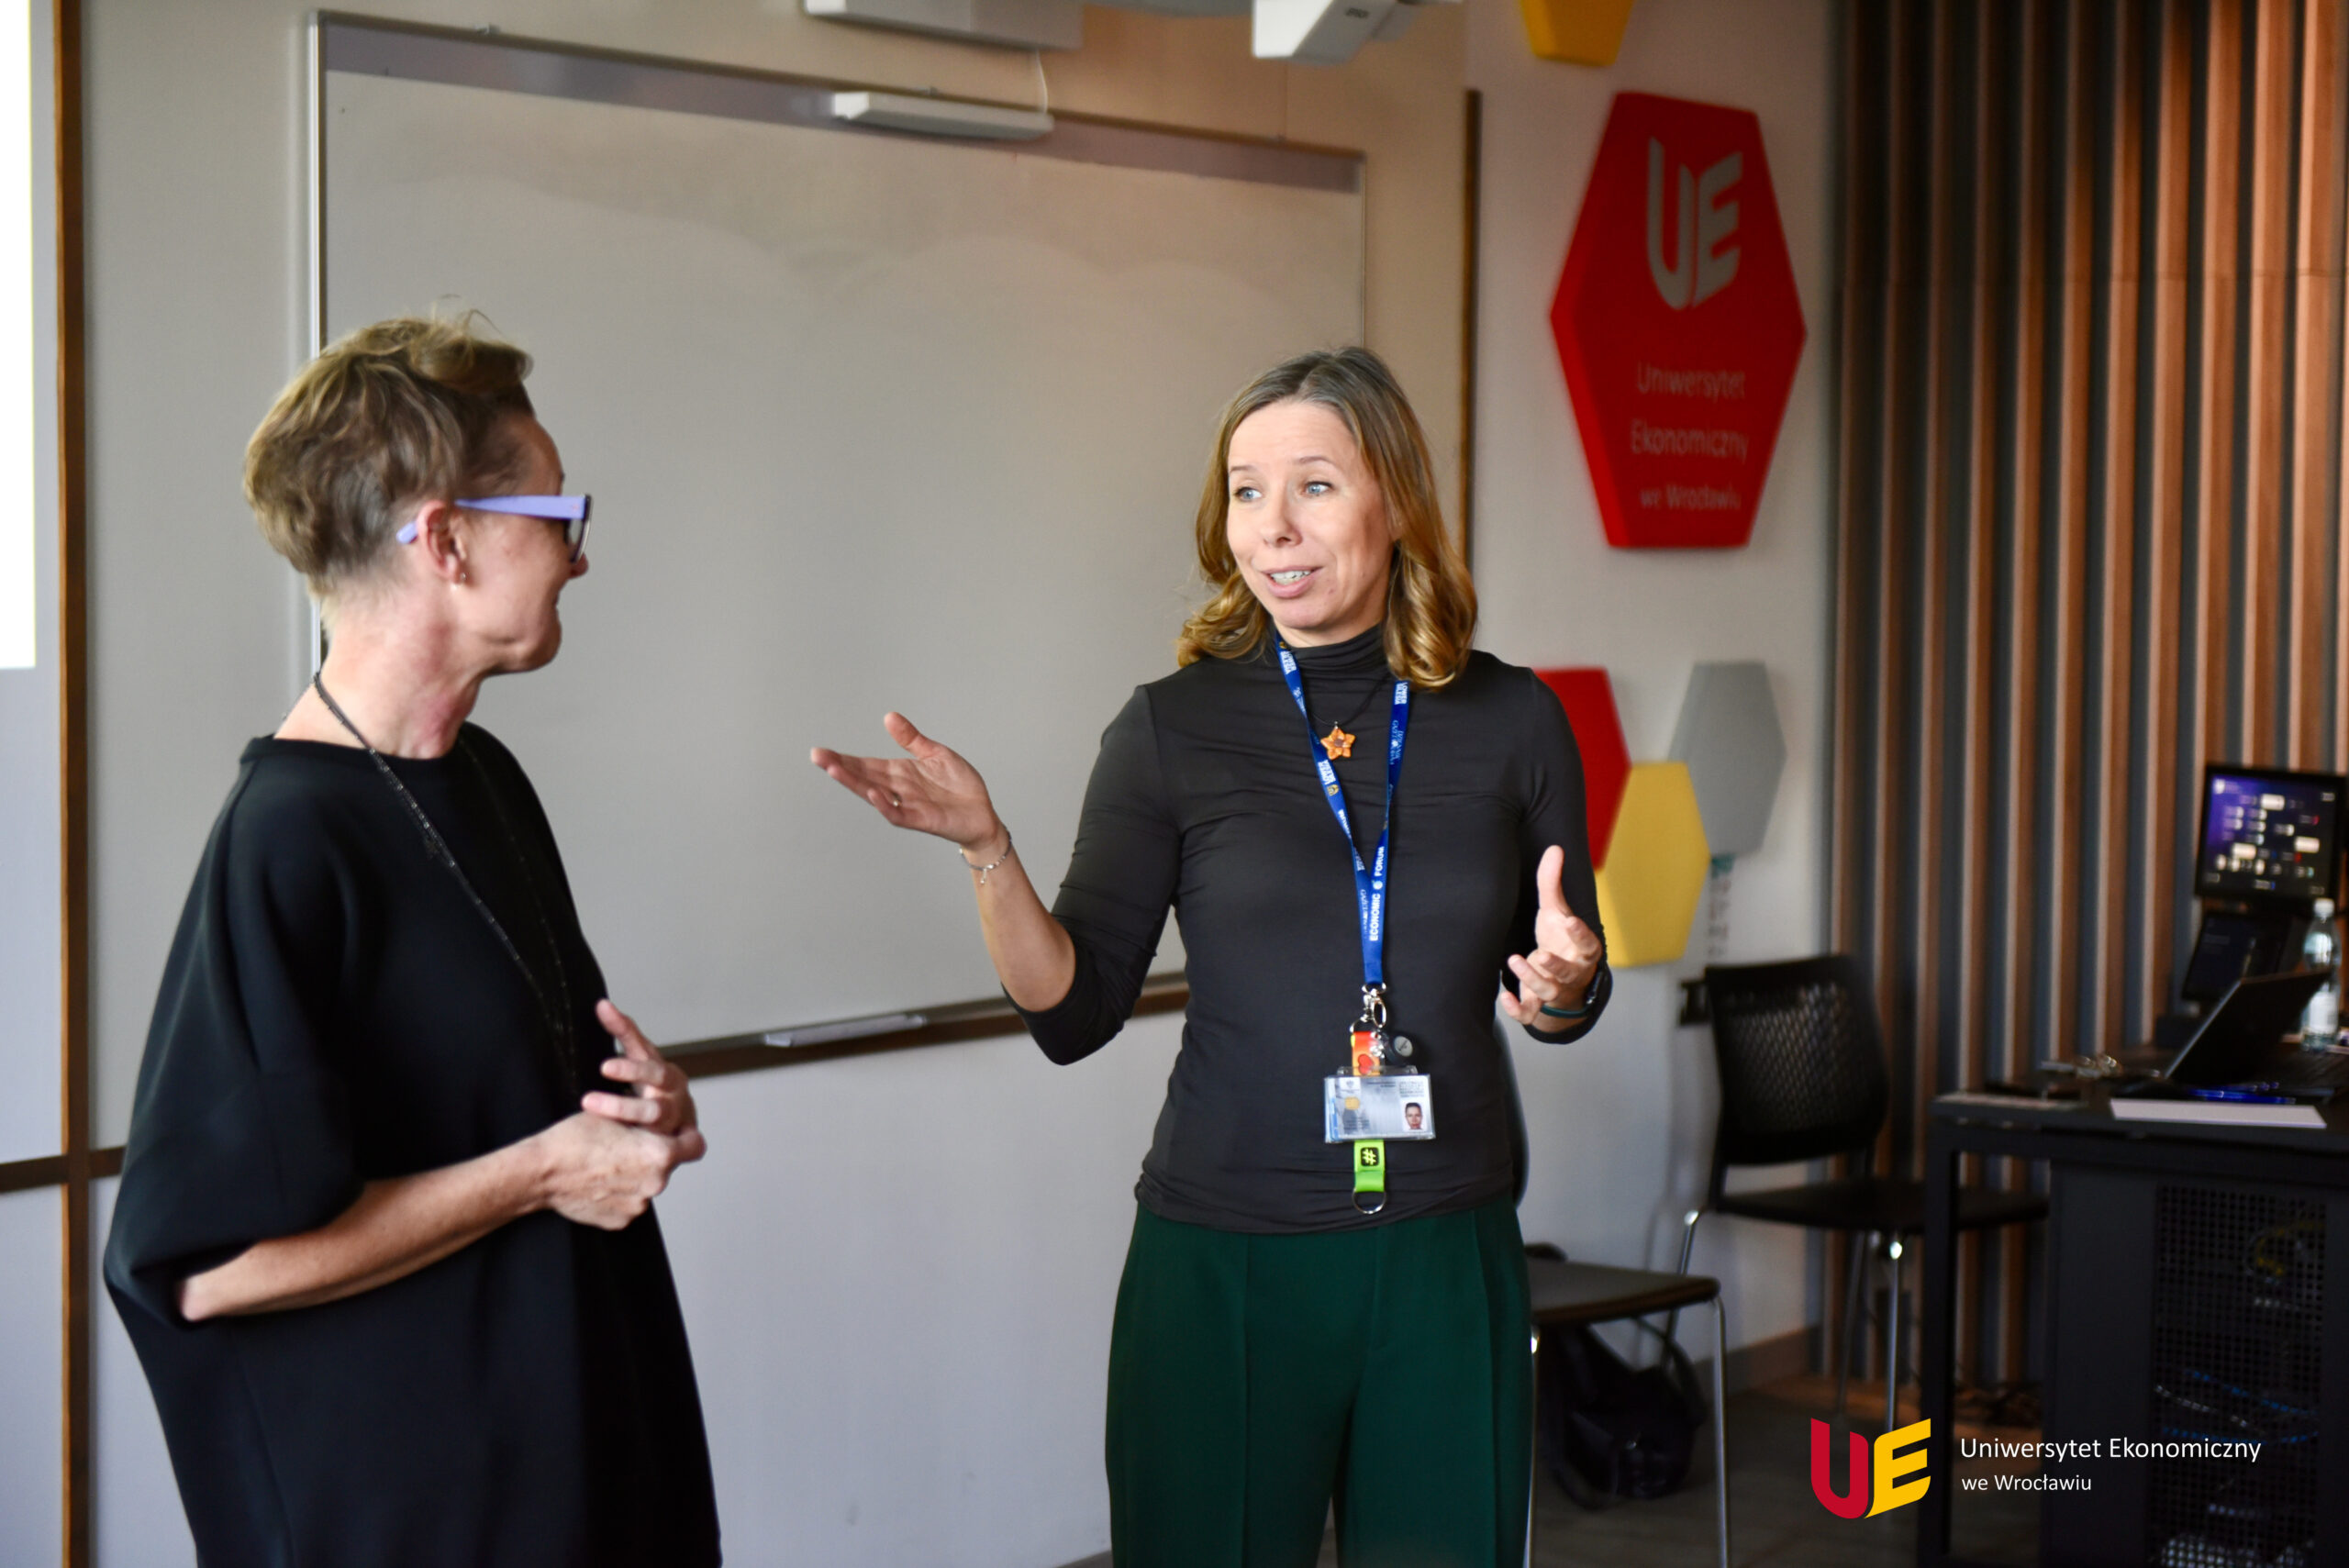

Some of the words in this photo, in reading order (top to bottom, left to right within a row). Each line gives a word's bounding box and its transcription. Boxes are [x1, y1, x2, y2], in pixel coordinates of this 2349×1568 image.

[1647, 135, 1743, 310] UE
[1636, 361, 1745, 404] Uniwersytet
[1631, 417, 1750, 465] Ekonomiczny
[1640, 487, 1661, 509] we
[1400, 682, 1408, 705] LOWER
[1374, 846, 1385, 876] FORUM
[1369, 894, 1381, 941] ECONOMIC
